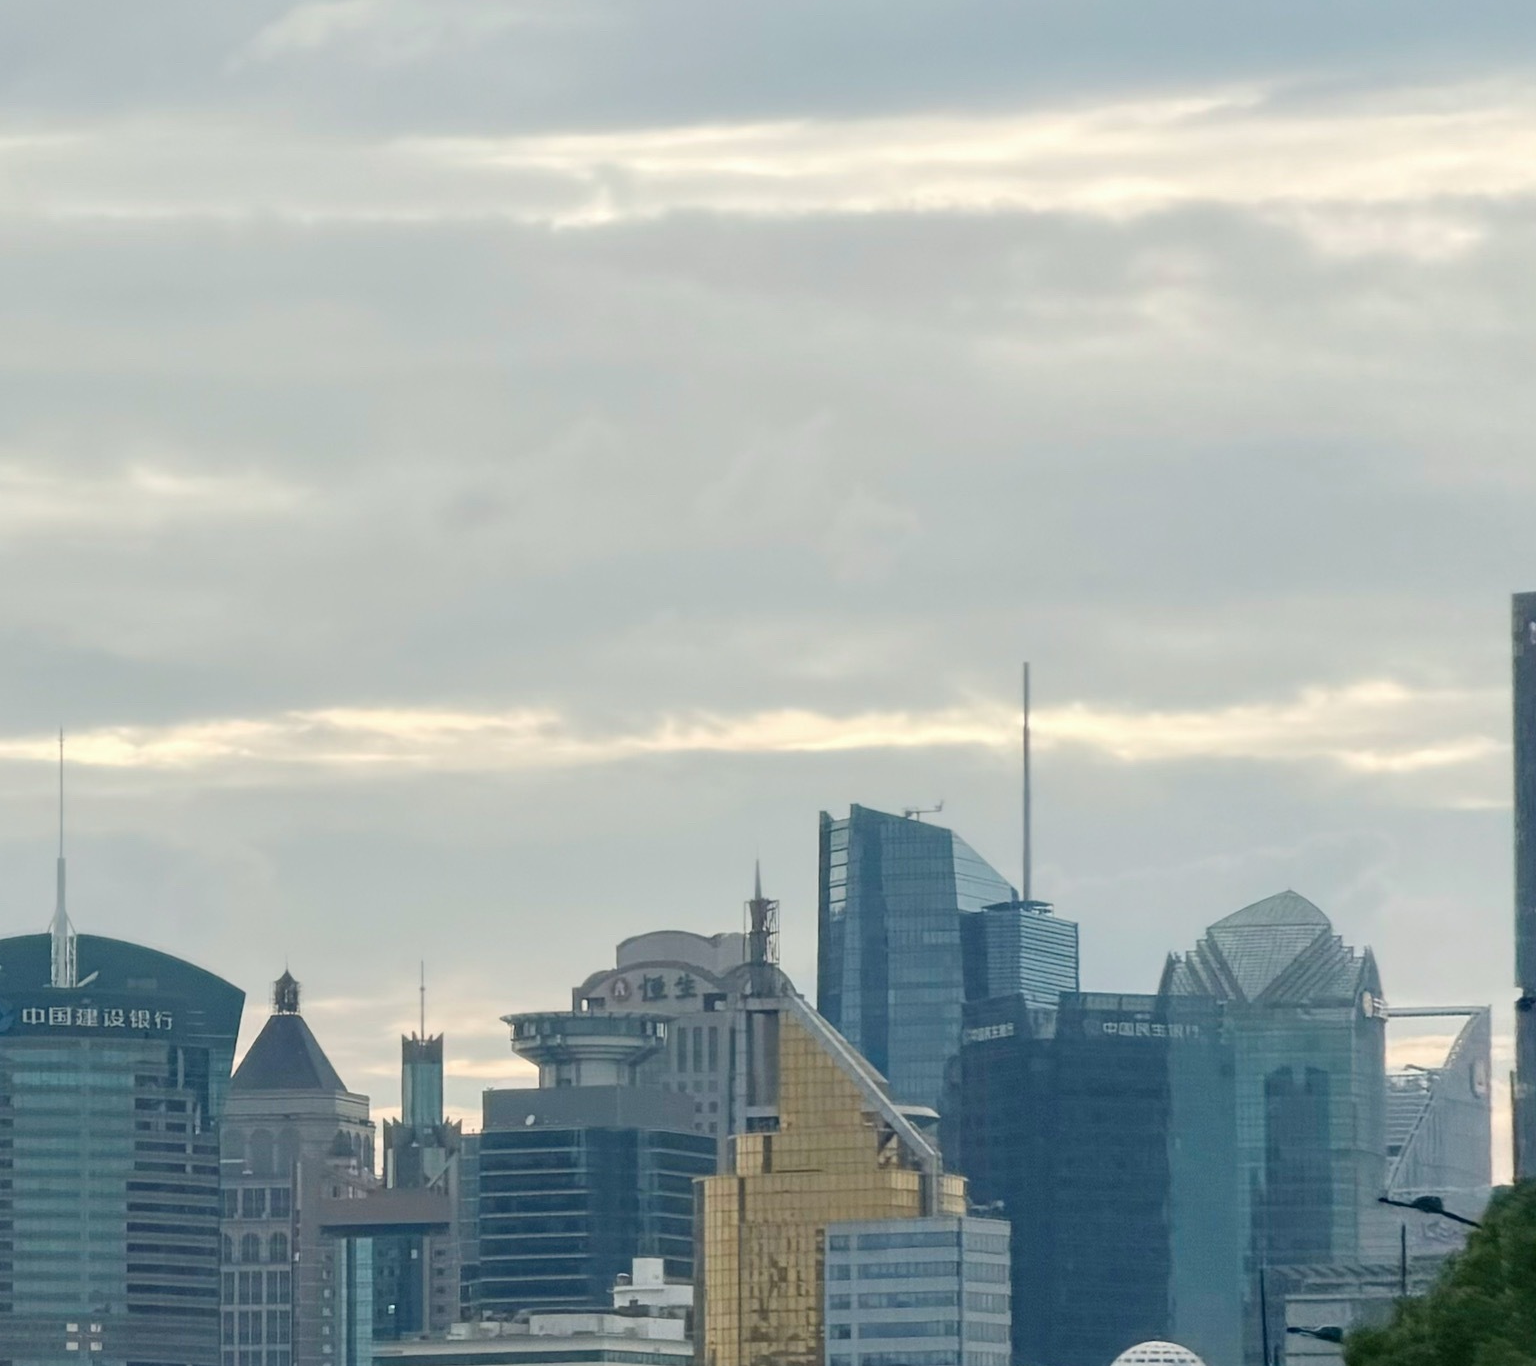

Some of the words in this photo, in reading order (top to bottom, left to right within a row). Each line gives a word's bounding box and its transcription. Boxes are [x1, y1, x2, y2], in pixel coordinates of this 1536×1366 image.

[637, 973, 698, 1002] 恒生
[21, 1005, 173, 1031] 中国建设银行
